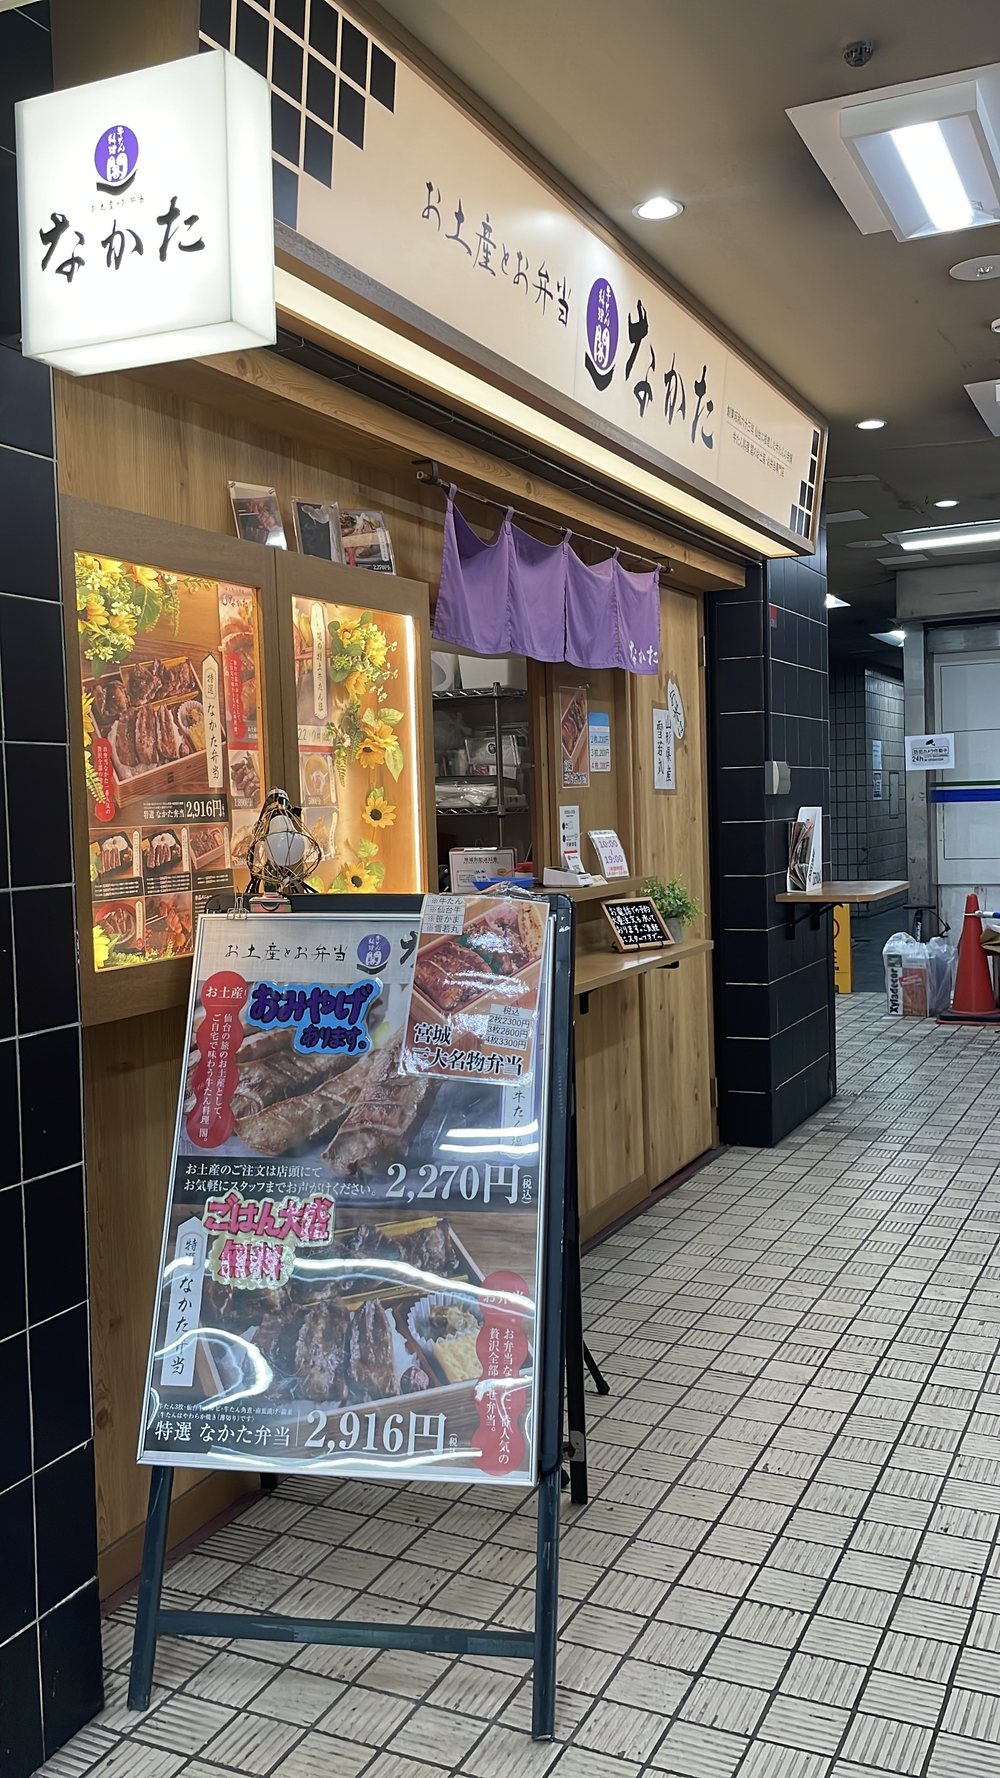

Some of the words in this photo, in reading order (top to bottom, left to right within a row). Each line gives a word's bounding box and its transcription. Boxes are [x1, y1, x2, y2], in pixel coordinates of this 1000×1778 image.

[39, 195, 206, 283] なかた
[422, 181, 572, 327] お土産とお弁当
[625, 299, 714, 450] なかた
[629, 640, 658, 666] なかた
[156, 809, 185, 819] なかた弁当
[186, 800, 222, 819] 2,916円
[599, 840, 618, 848] 10:00
[605, 855, 624, 864] 19:00
[427, 924, 458, 933] ※雪若丸
[225, 942, 348, 963] お土産とお弁当
[889, 968, 900, 1013] Xyladecor
[250, 983, 374, 1025] おみやげ
[503, 1006, 519, 1016] 税込
[414, 1023, 452, 1045] 宮城
[487, 1025, 529, 1039] 3枚2800円
[489, 1015, 530, 1029] 2枚2300円
[300, 1024, 367, 1052] あります。
[485, 1035, 526, 1049] 4枚3300円
[214, 1014, 233, 1119] 仙台の旅のお土産として、
[412, 1048, 523, 1076] 三大名物弁当
[185, 1163, 322, 1178] お土産のご注文は店頭にて
[385, 1163, 521, 1204] 2,270円
[184, 1179, 376, 1195] お気軽にスタッフまでお声がけください。
[203, 1192, 333, 1240] ごはん大盛
[217, 1239, 283, 1280] 無料
[155, 1420, 192, 1441] 特選
[200, 1423, 290, 1447] なかた弁当
[304, 1409, 447, 1456] 2,916円
